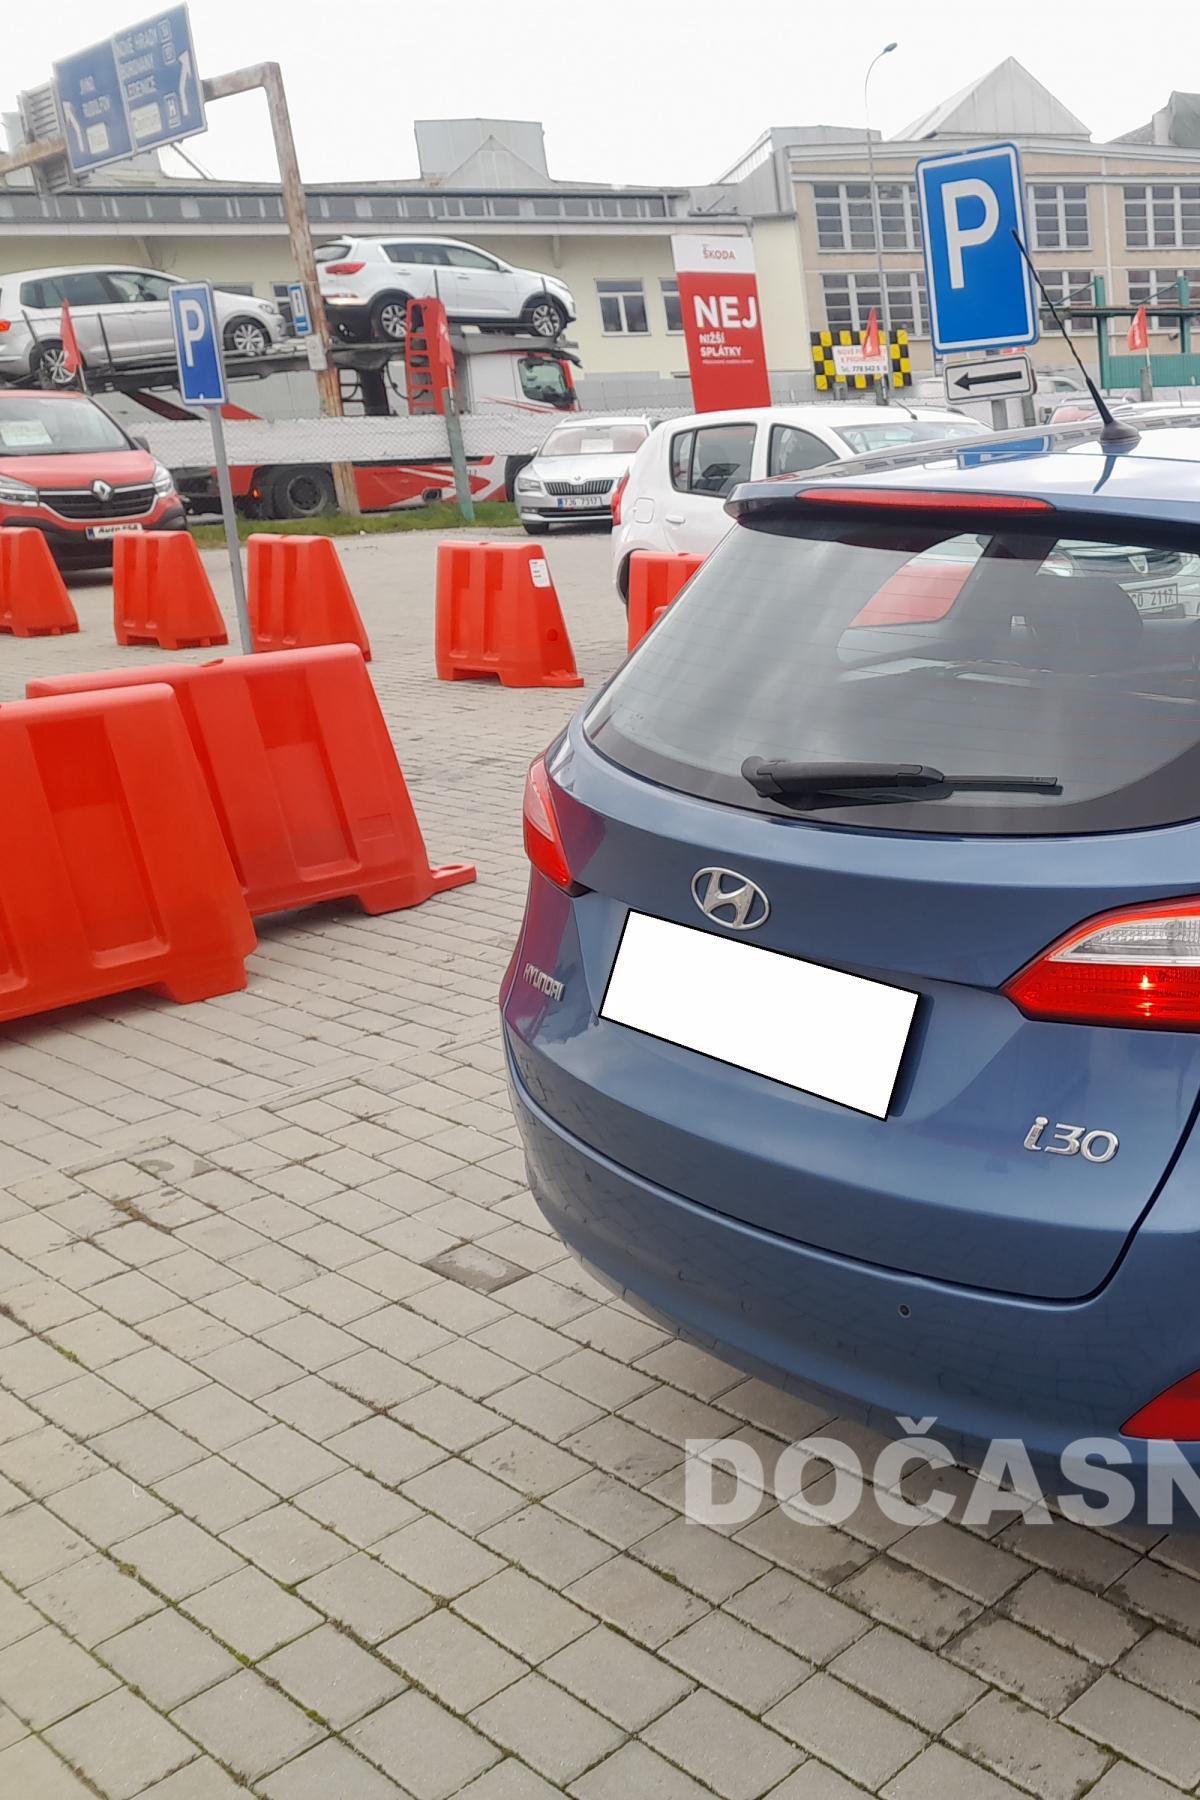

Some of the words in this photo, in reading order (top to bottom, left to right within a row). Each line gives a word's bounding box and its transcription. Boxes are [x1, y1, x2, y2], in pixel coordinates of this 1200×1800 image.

[702, 246, 736, 261] ŠKODA
[940, 177, 1000, 290] P
[692, 294, 758, 330] NEJ
[179, 298, 206, 368] P
[700, 344, 742, 358] SPLÁTKY
[522, 962, 565, 1002] HYUNDAI
[1022, 1115, 1120, 1163] i30
